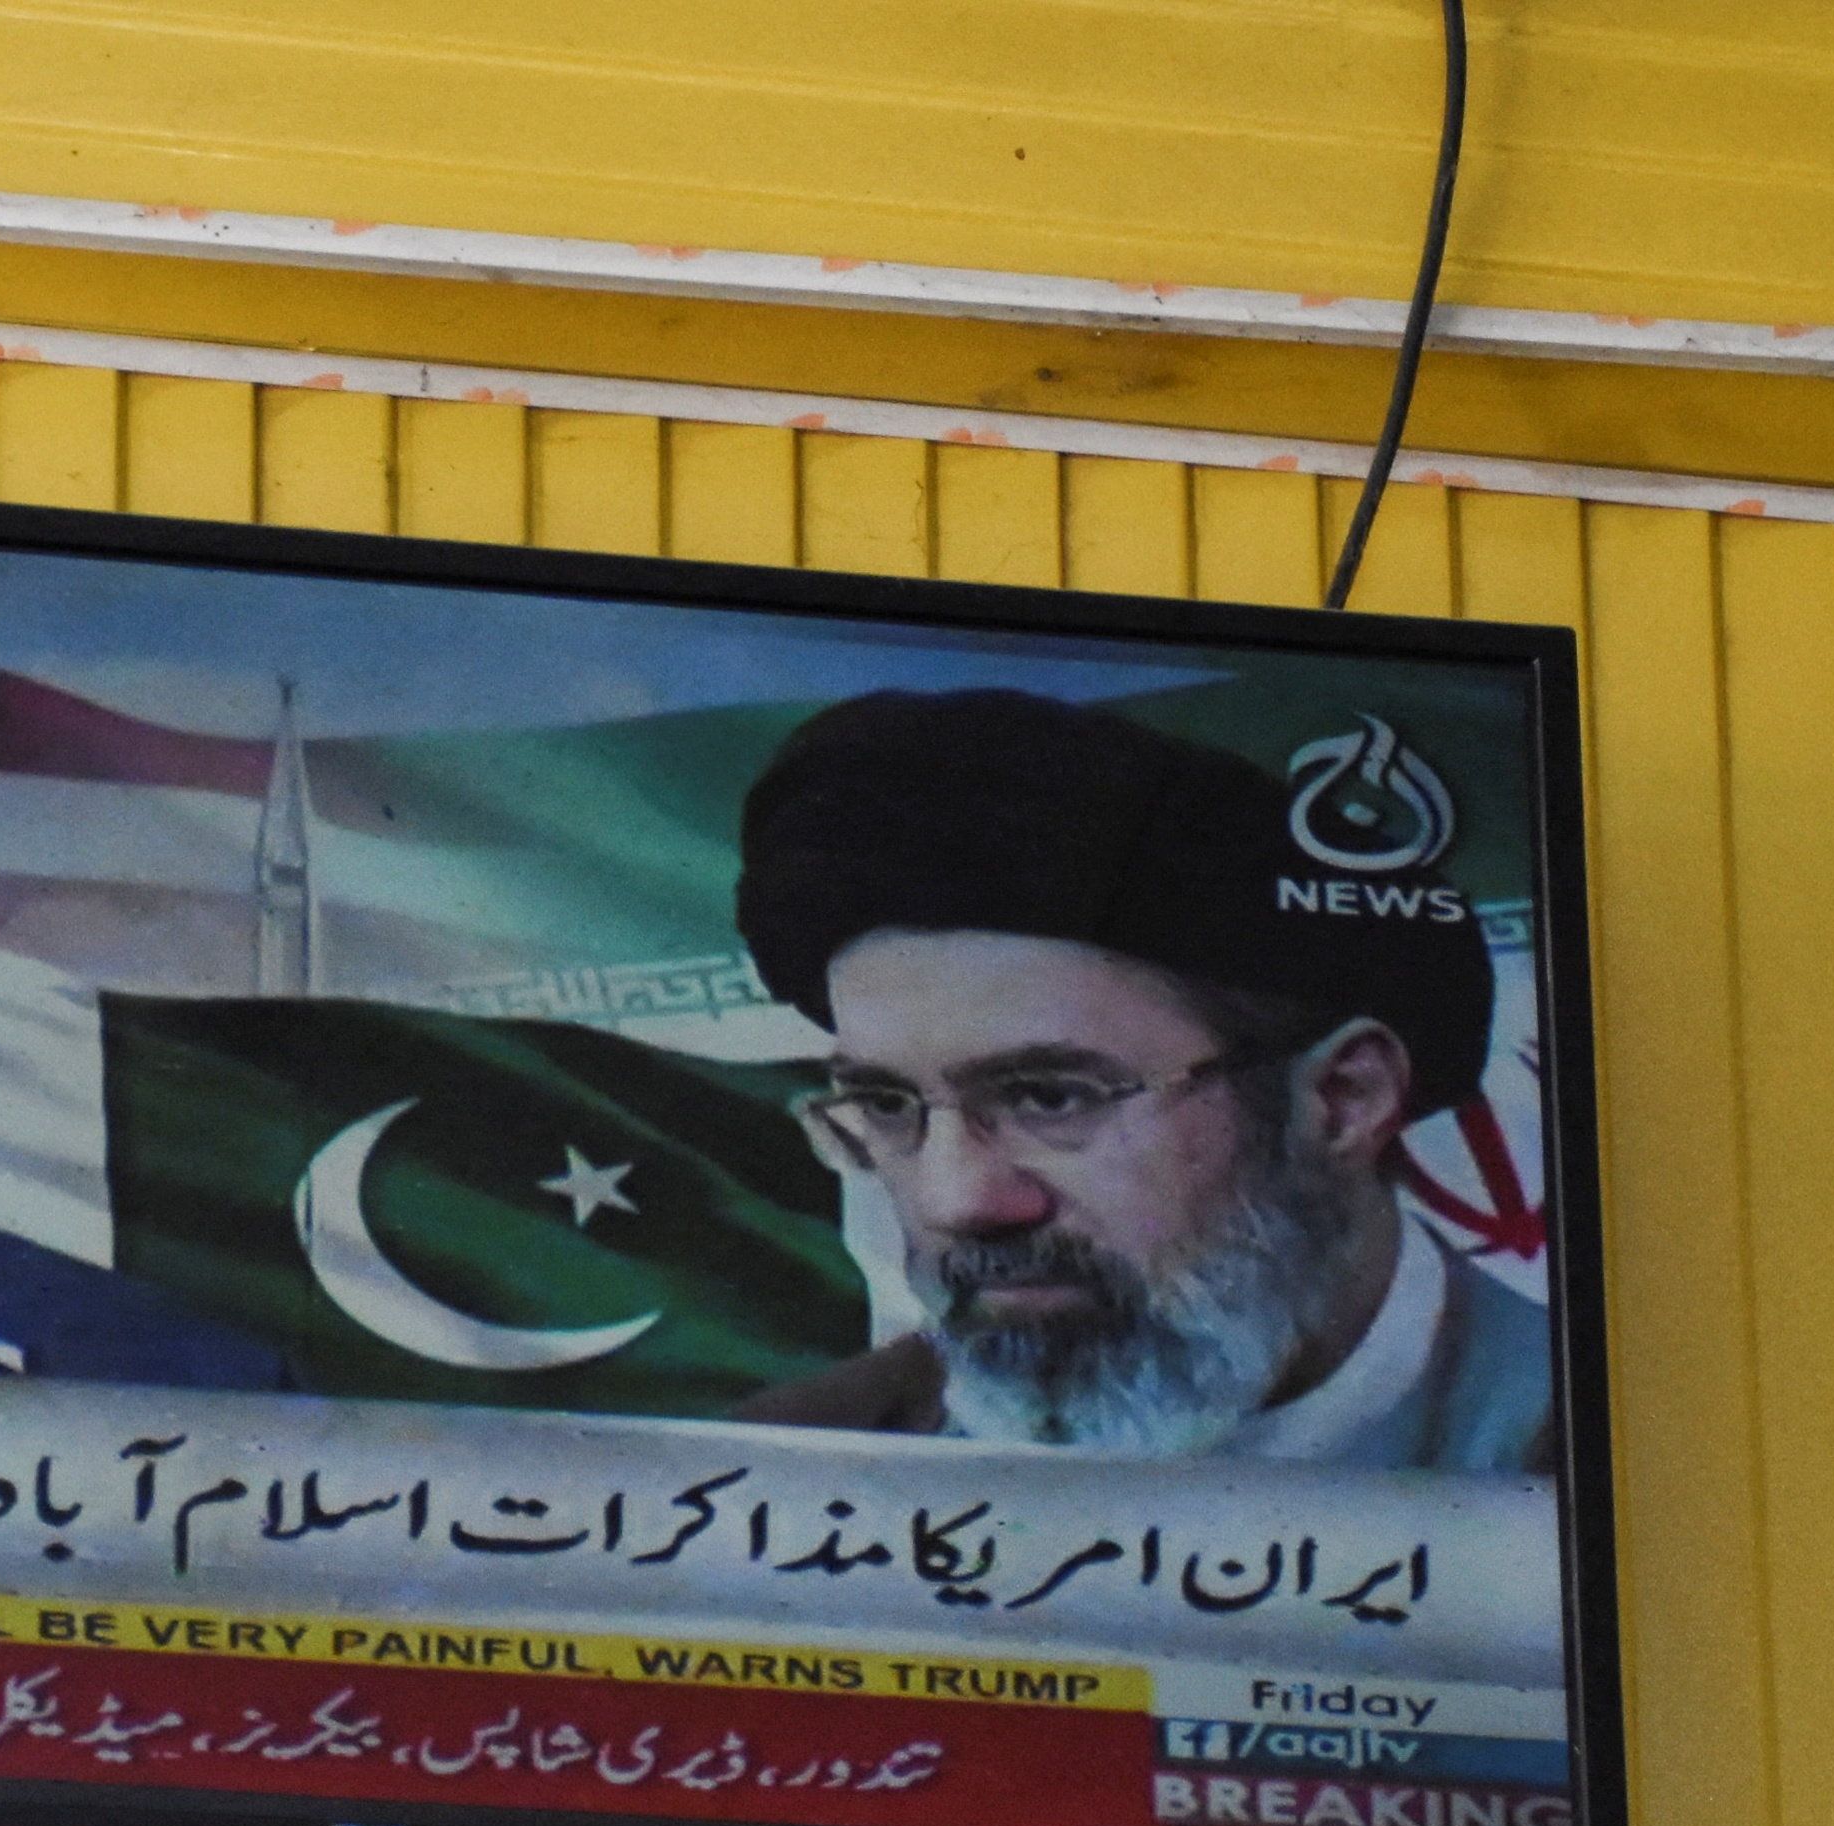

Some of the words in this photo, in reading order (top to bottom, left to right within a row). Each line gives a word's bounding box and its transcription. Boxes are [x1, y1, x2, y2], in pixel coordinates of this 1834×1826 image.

[1276, 877, 1467, 924] NEWS
[174, 1469, 431, 1576] اسلام
[450, 1467, 894, 1576] مذاکرات
[911, 1501, 1161, 1608] امریکا
[1182, 1536, 1430, 1625] ایران
[38, 1608, 120, 1645] BE
[142, 1616, 310, 1658] VERY
[635, 1645, 865, 1690] WARNS
[887, 1661, 1101, 1705] TRUMP
[1250, 1679, 1439, 1728] Friday
